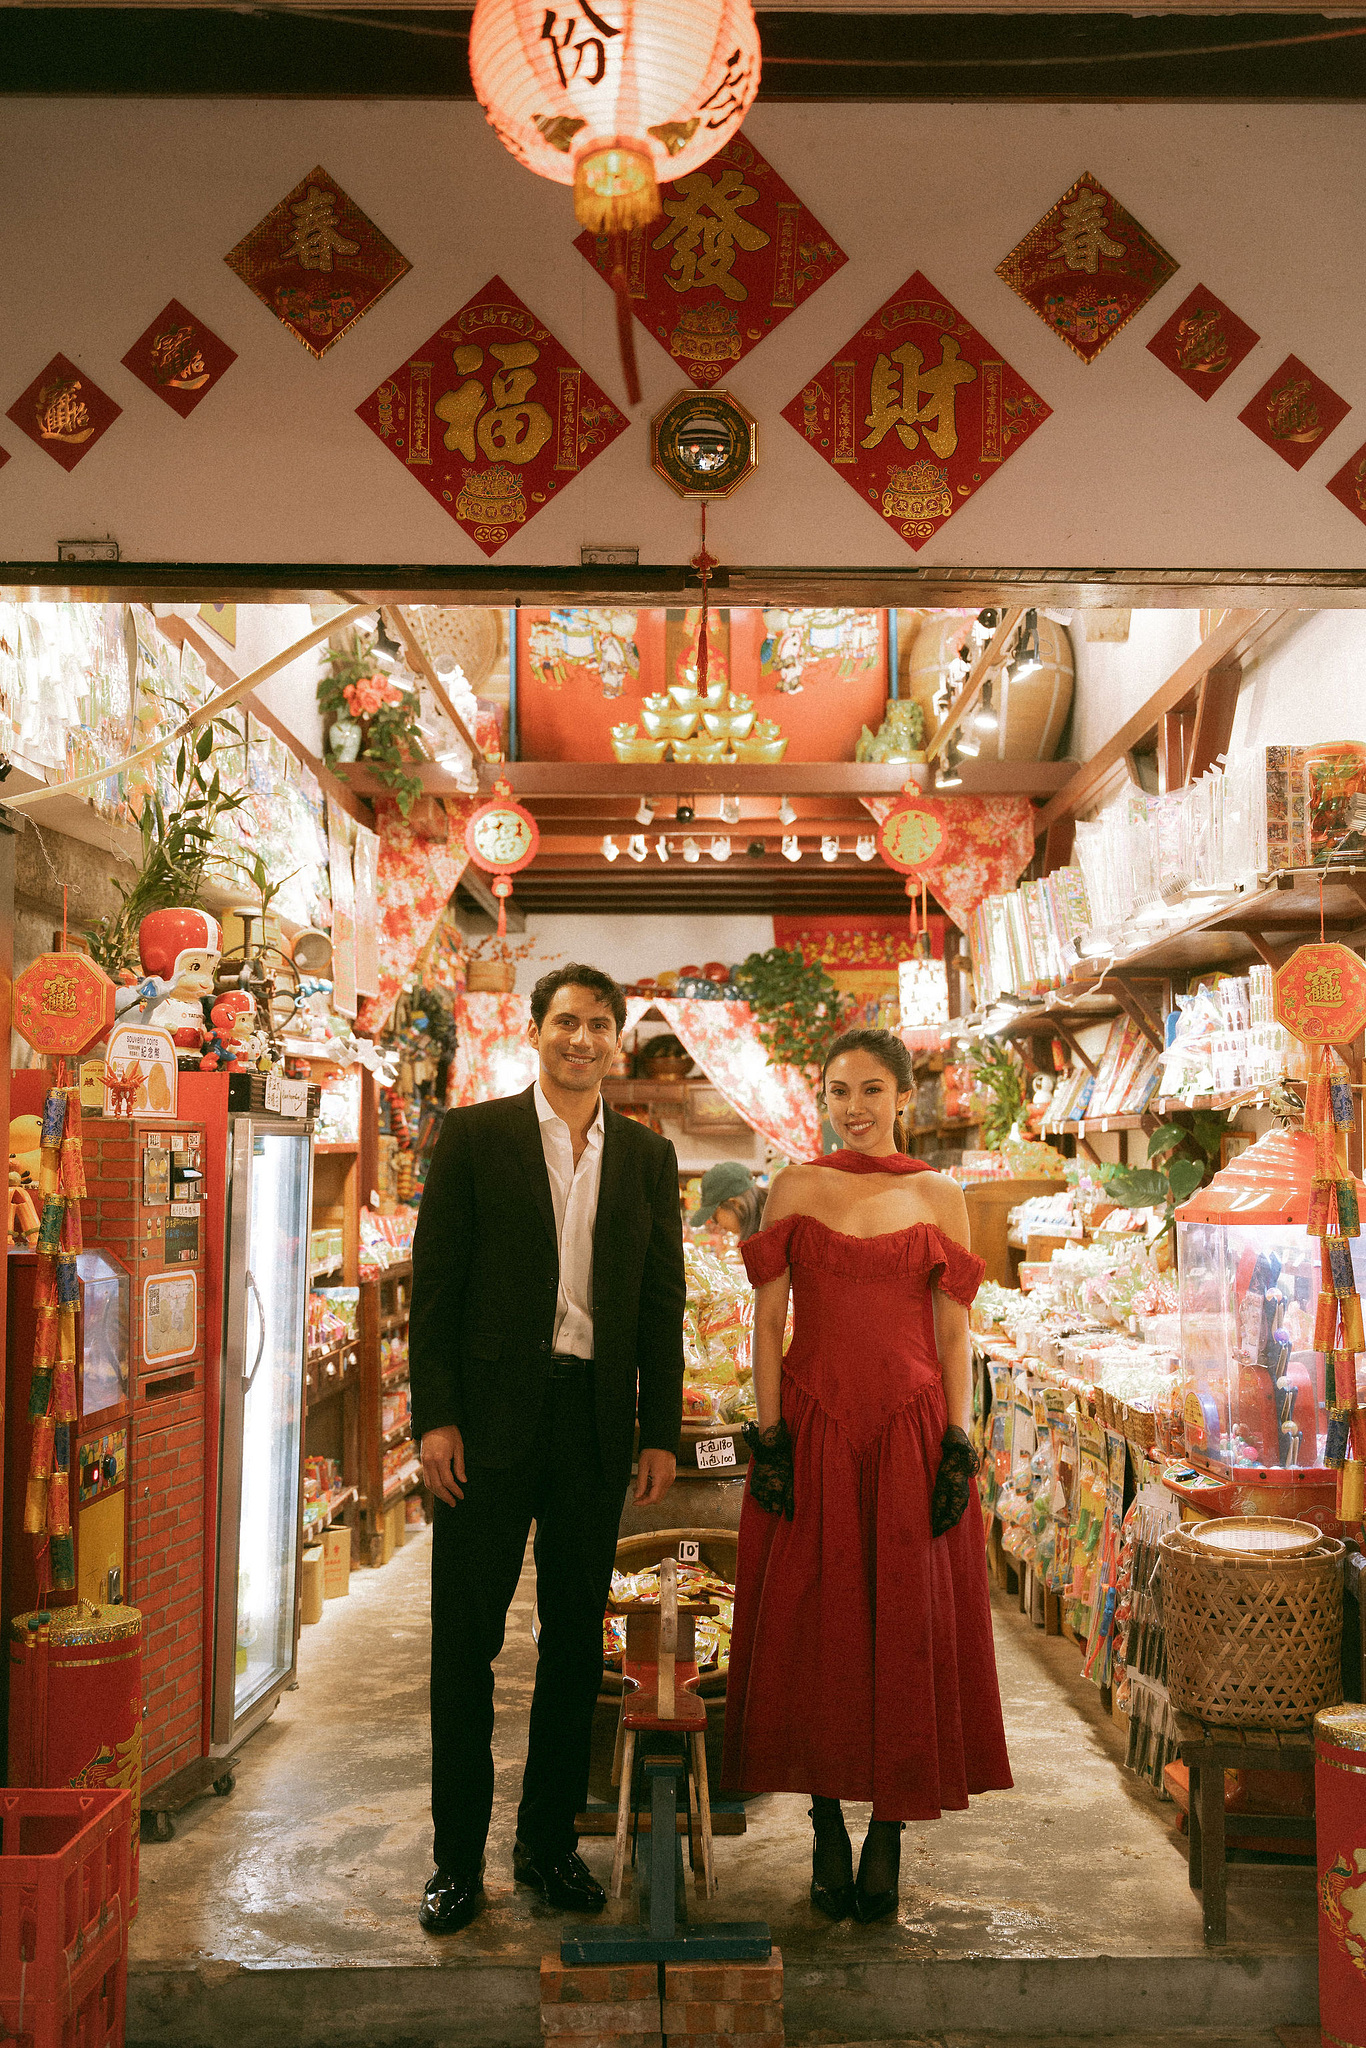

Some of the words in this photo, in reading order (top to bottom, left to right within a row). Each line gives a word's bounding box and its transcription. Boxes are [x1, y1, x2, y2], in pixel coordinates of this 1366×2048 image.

[280, 184, 362, 274] 春
[651, 169, 771, 301] 發
[1047, 186, 1128, 275] 春
[434, 339, 554, 465] 福
[561, 380, 576, 458] 五福百福全家福
[859, 333, 978, 459] 財
